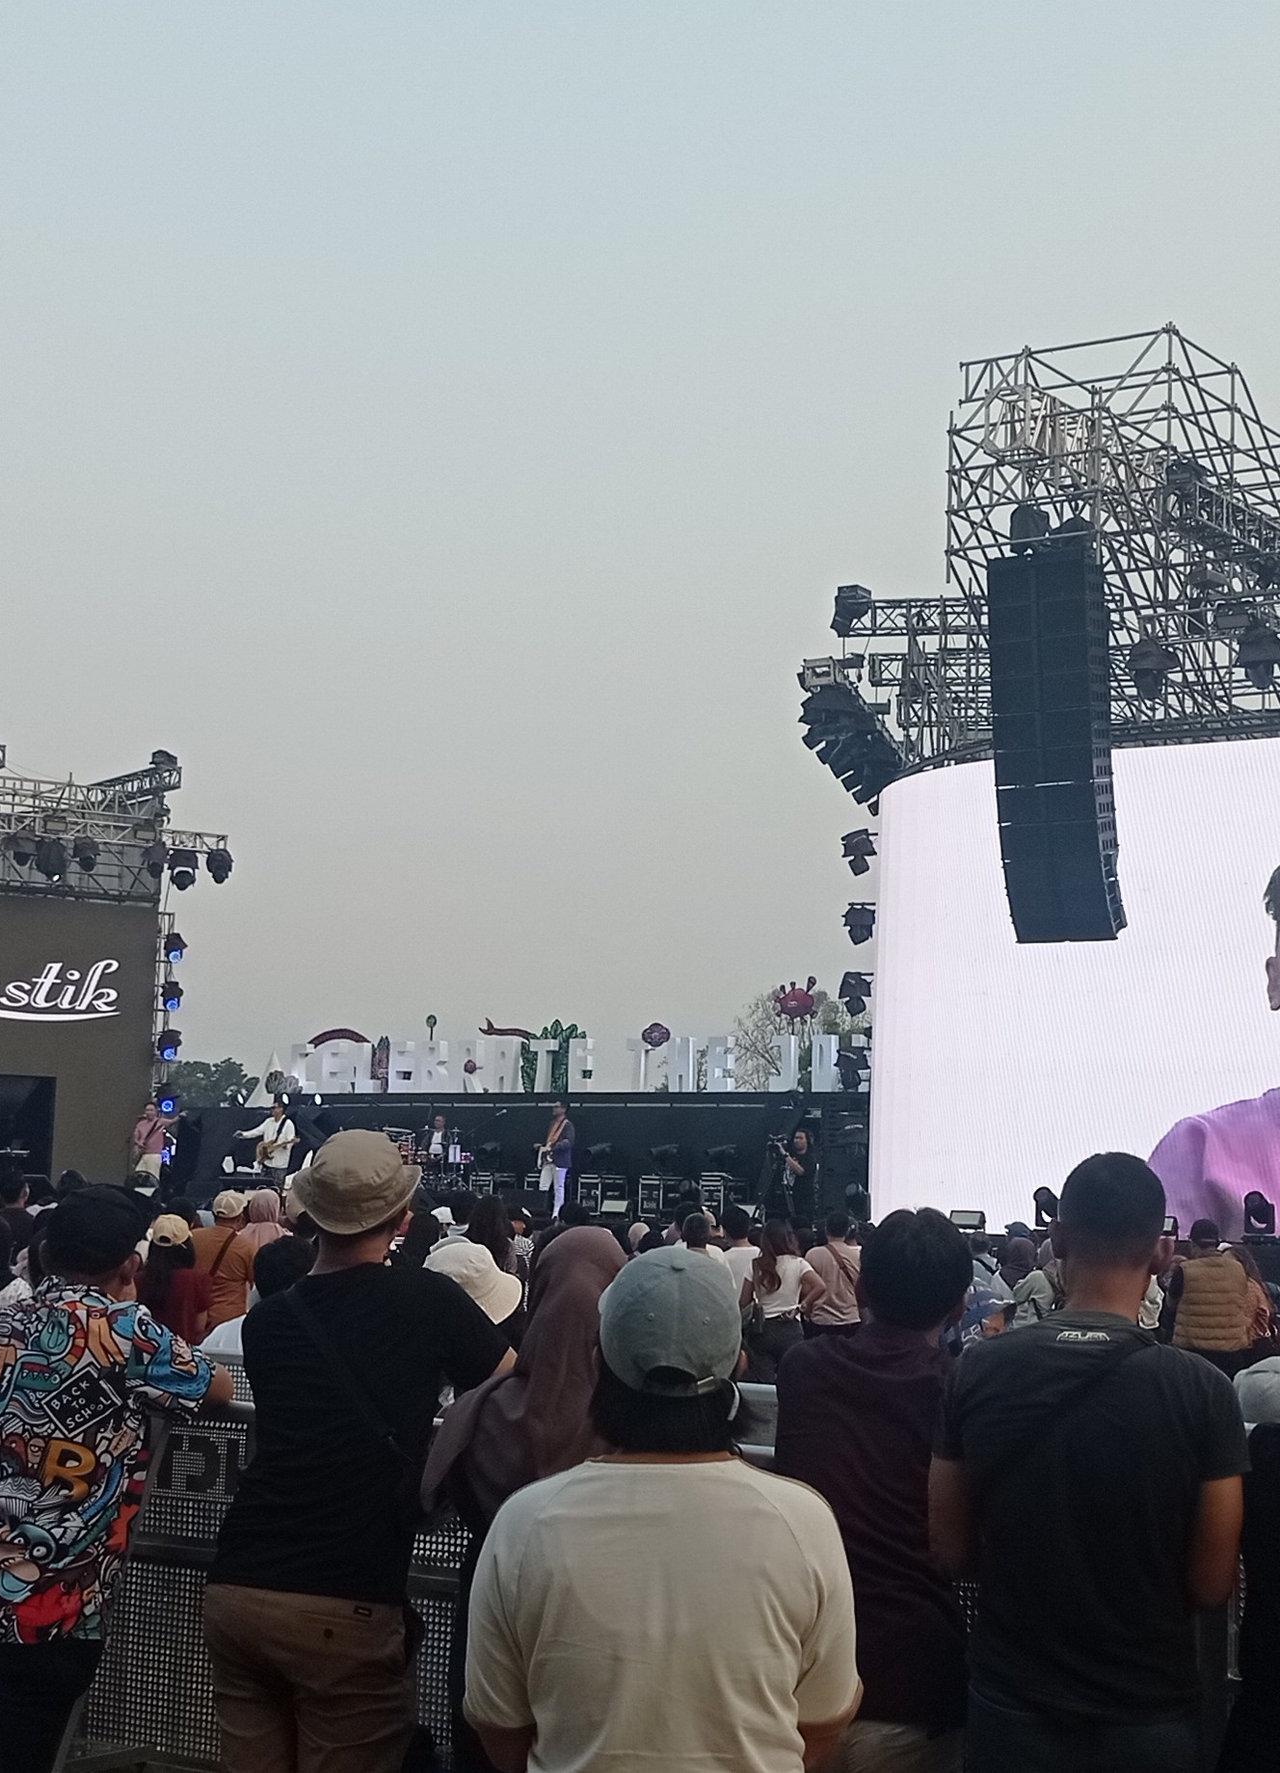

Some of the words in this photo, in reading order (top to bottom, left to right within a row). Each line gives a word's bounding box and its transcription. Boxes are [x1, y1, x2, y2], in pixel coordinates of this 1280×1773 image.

[292, 1038, 594, 1093] CELEBRATE
[626, 1036, 736, 1093] THE
[51, 1380, 90, 1410] BACK
[71, 1398, 86, 1409] TO
[66, 1396, 111, 1429] SCHOOL
